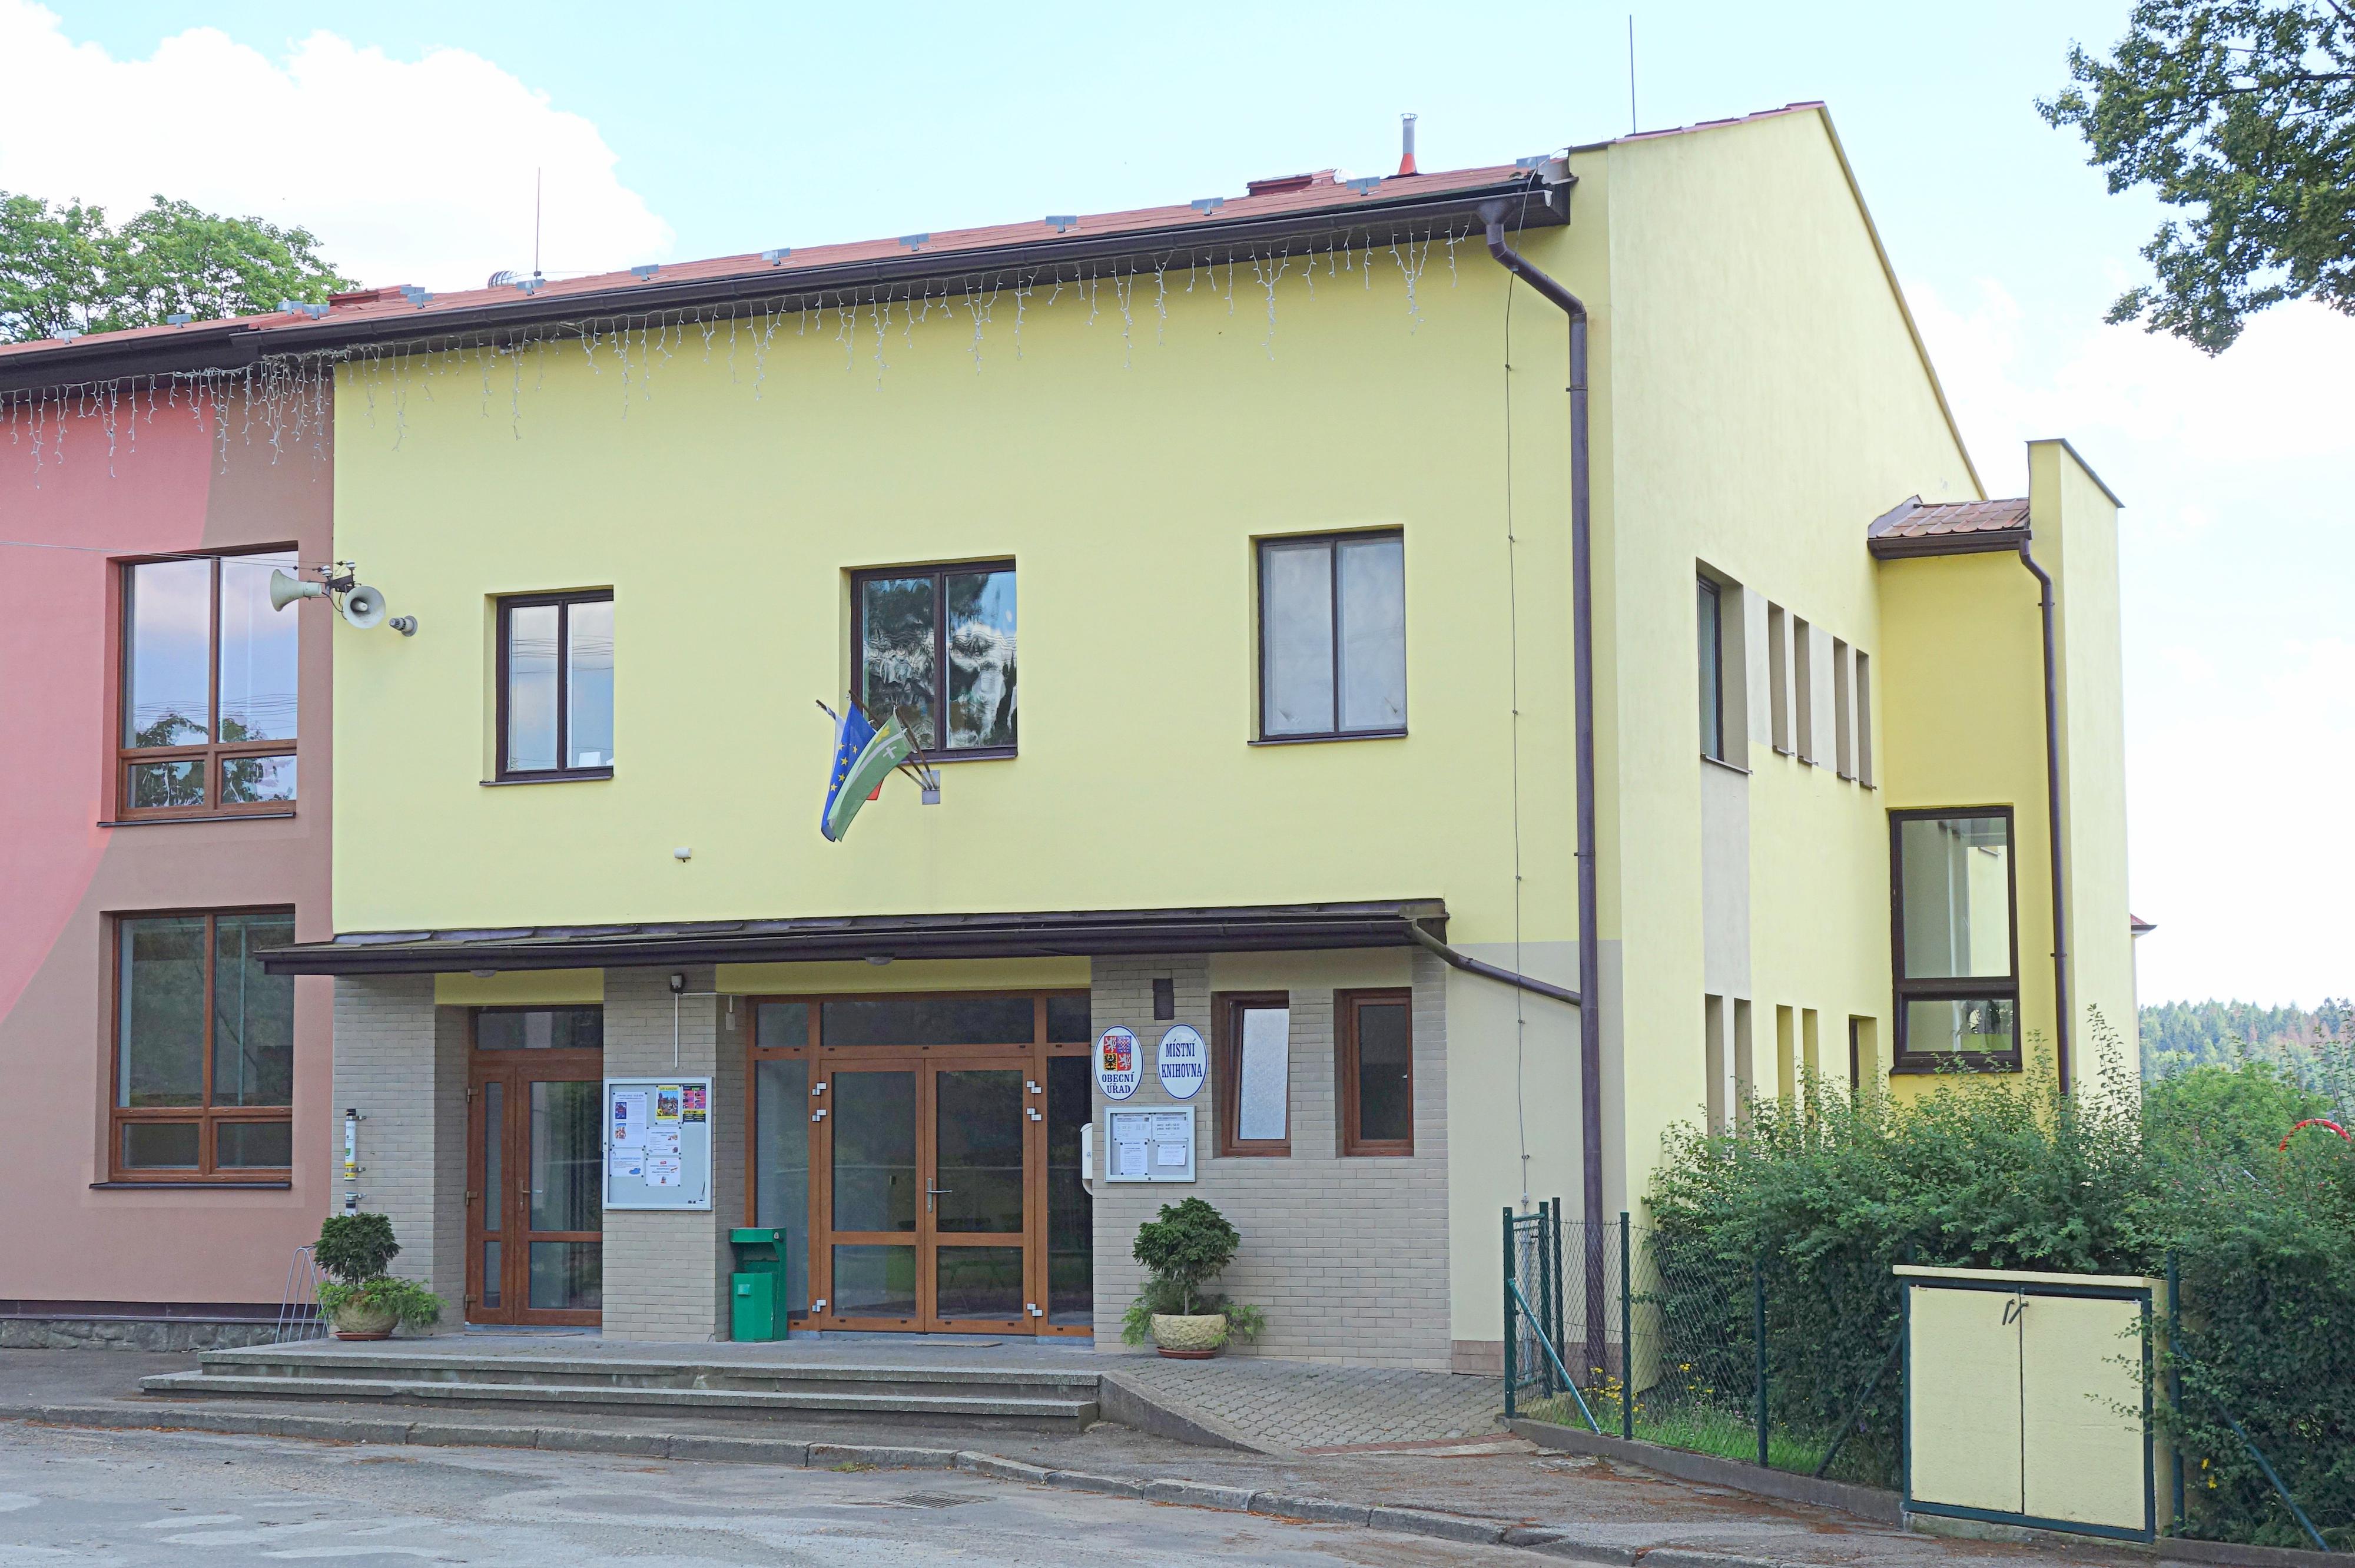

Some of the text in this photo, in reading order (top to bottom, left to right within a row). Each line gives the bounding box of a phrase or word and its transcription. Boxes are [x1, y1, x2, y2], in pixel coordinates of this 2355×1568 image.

[1166, 1038, 1196, 1058] MÍSTNÍ
[1161, 1063, 1203, 1078] KNIHOVNA
[1102, 1072, 1135, 1083] OBECNÍ
[1107, 1083, 1131, 1094] ÚŘAD
